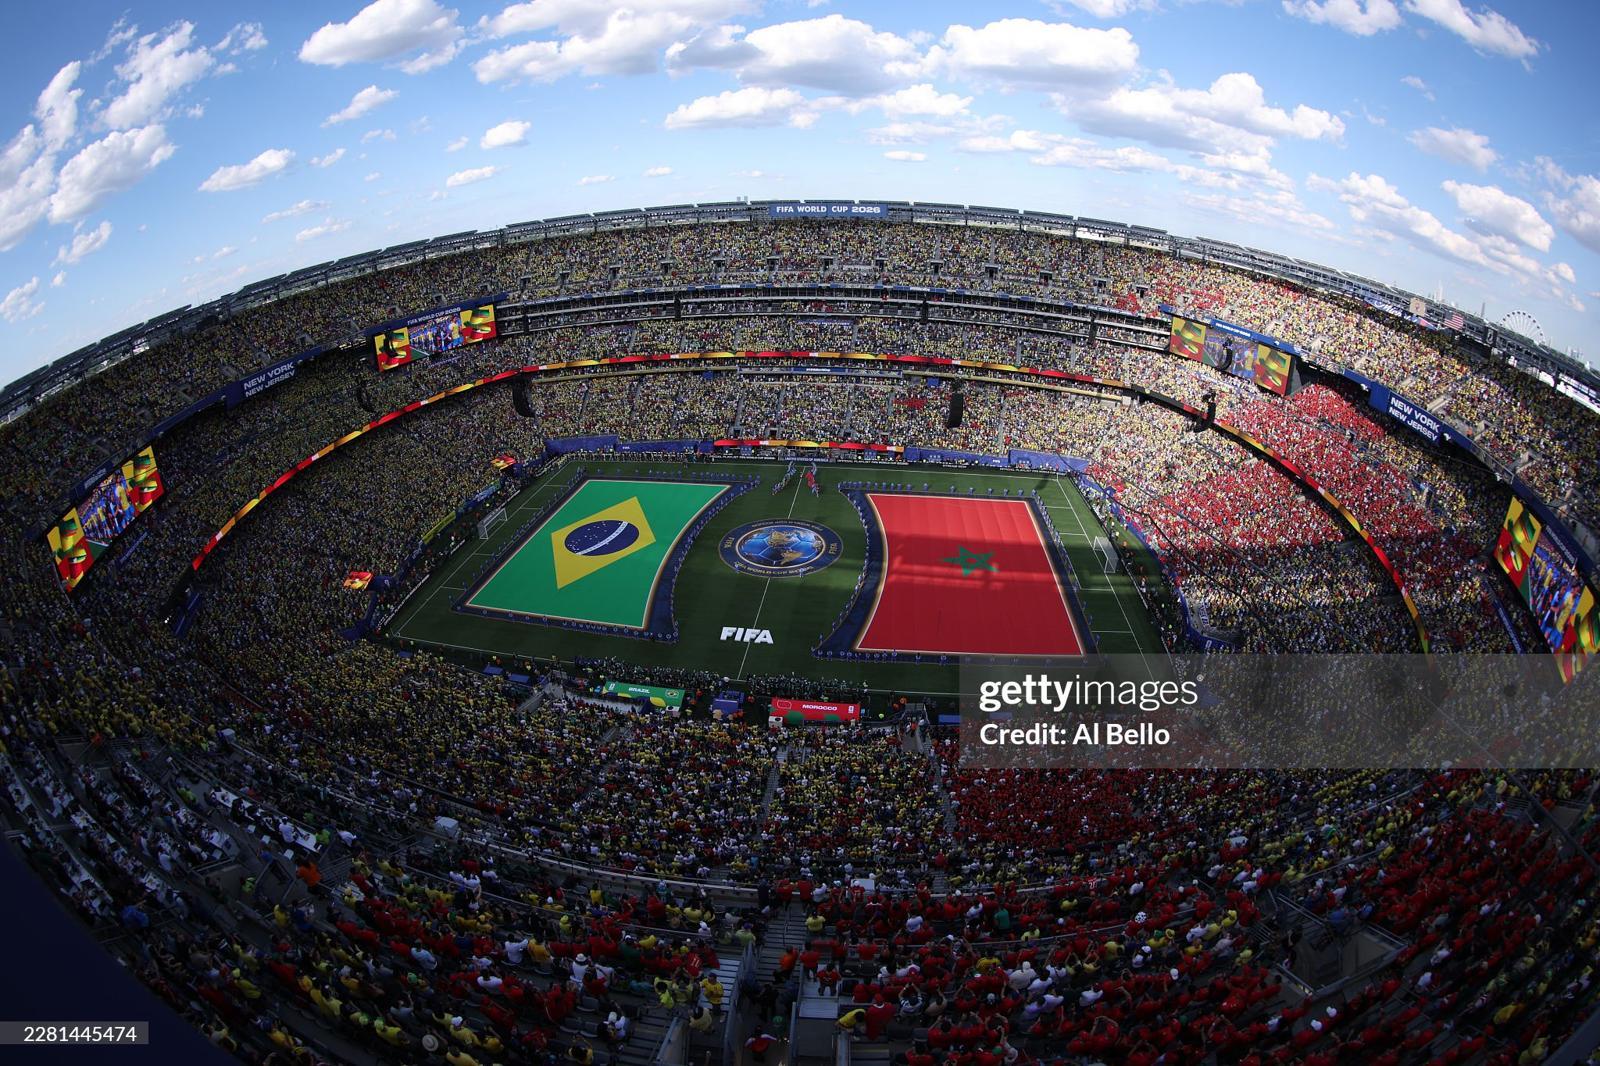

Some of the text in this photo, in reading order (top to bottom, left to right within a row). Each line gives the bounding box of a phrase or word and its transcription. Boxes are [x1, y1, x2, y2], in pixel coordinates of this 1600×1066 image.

[243, 362, 294, 390] NEW YORK
[245, 369, 296, 398] NEW JERSEY
[1388, 406, 1438, 441] NEW JERSEY
[1390, 397, 1440, 433] NEW YORK
[720, 626, 774, 644] FIFA
